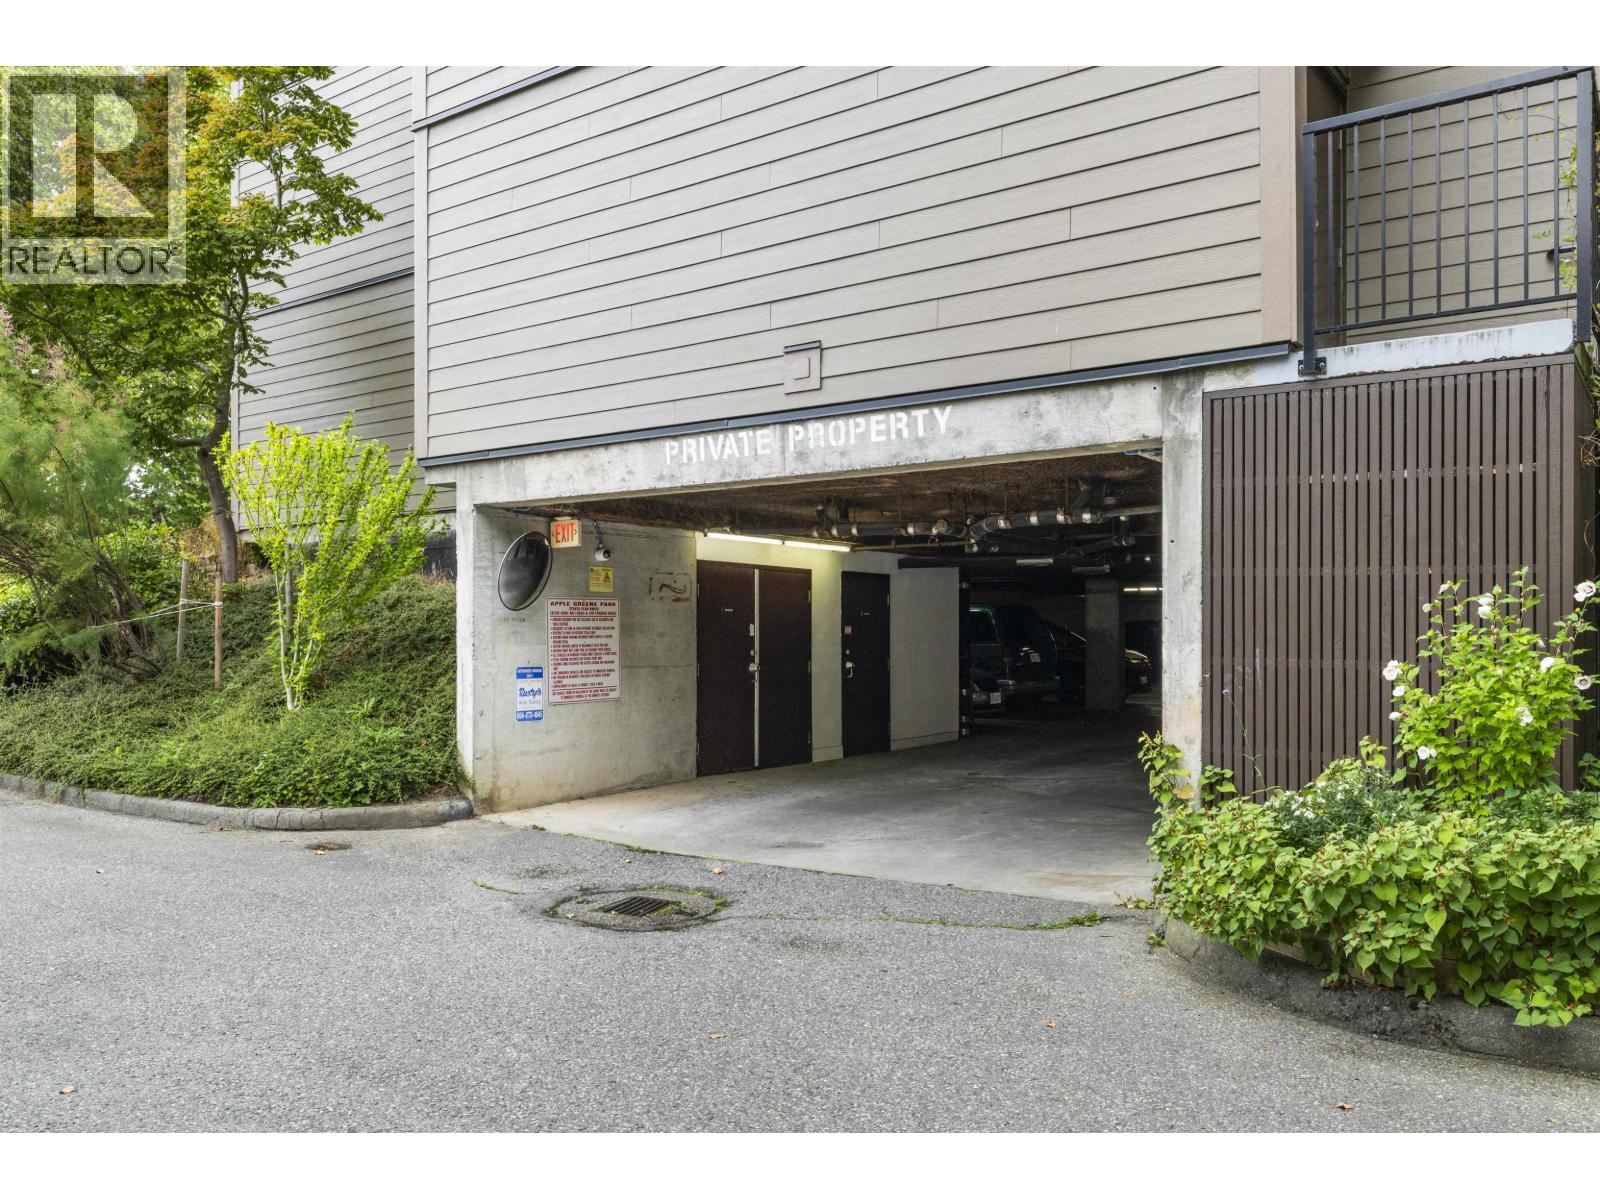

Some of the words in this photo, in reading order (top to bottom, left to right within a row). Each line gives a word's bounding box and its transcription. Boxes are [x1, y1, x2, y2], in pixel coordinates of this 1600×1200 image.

[665, 429, 771, 465] PRIVATE
[788, 405, 952, 452] PROPERTY
[555, 522, 576, 544] EXIT
